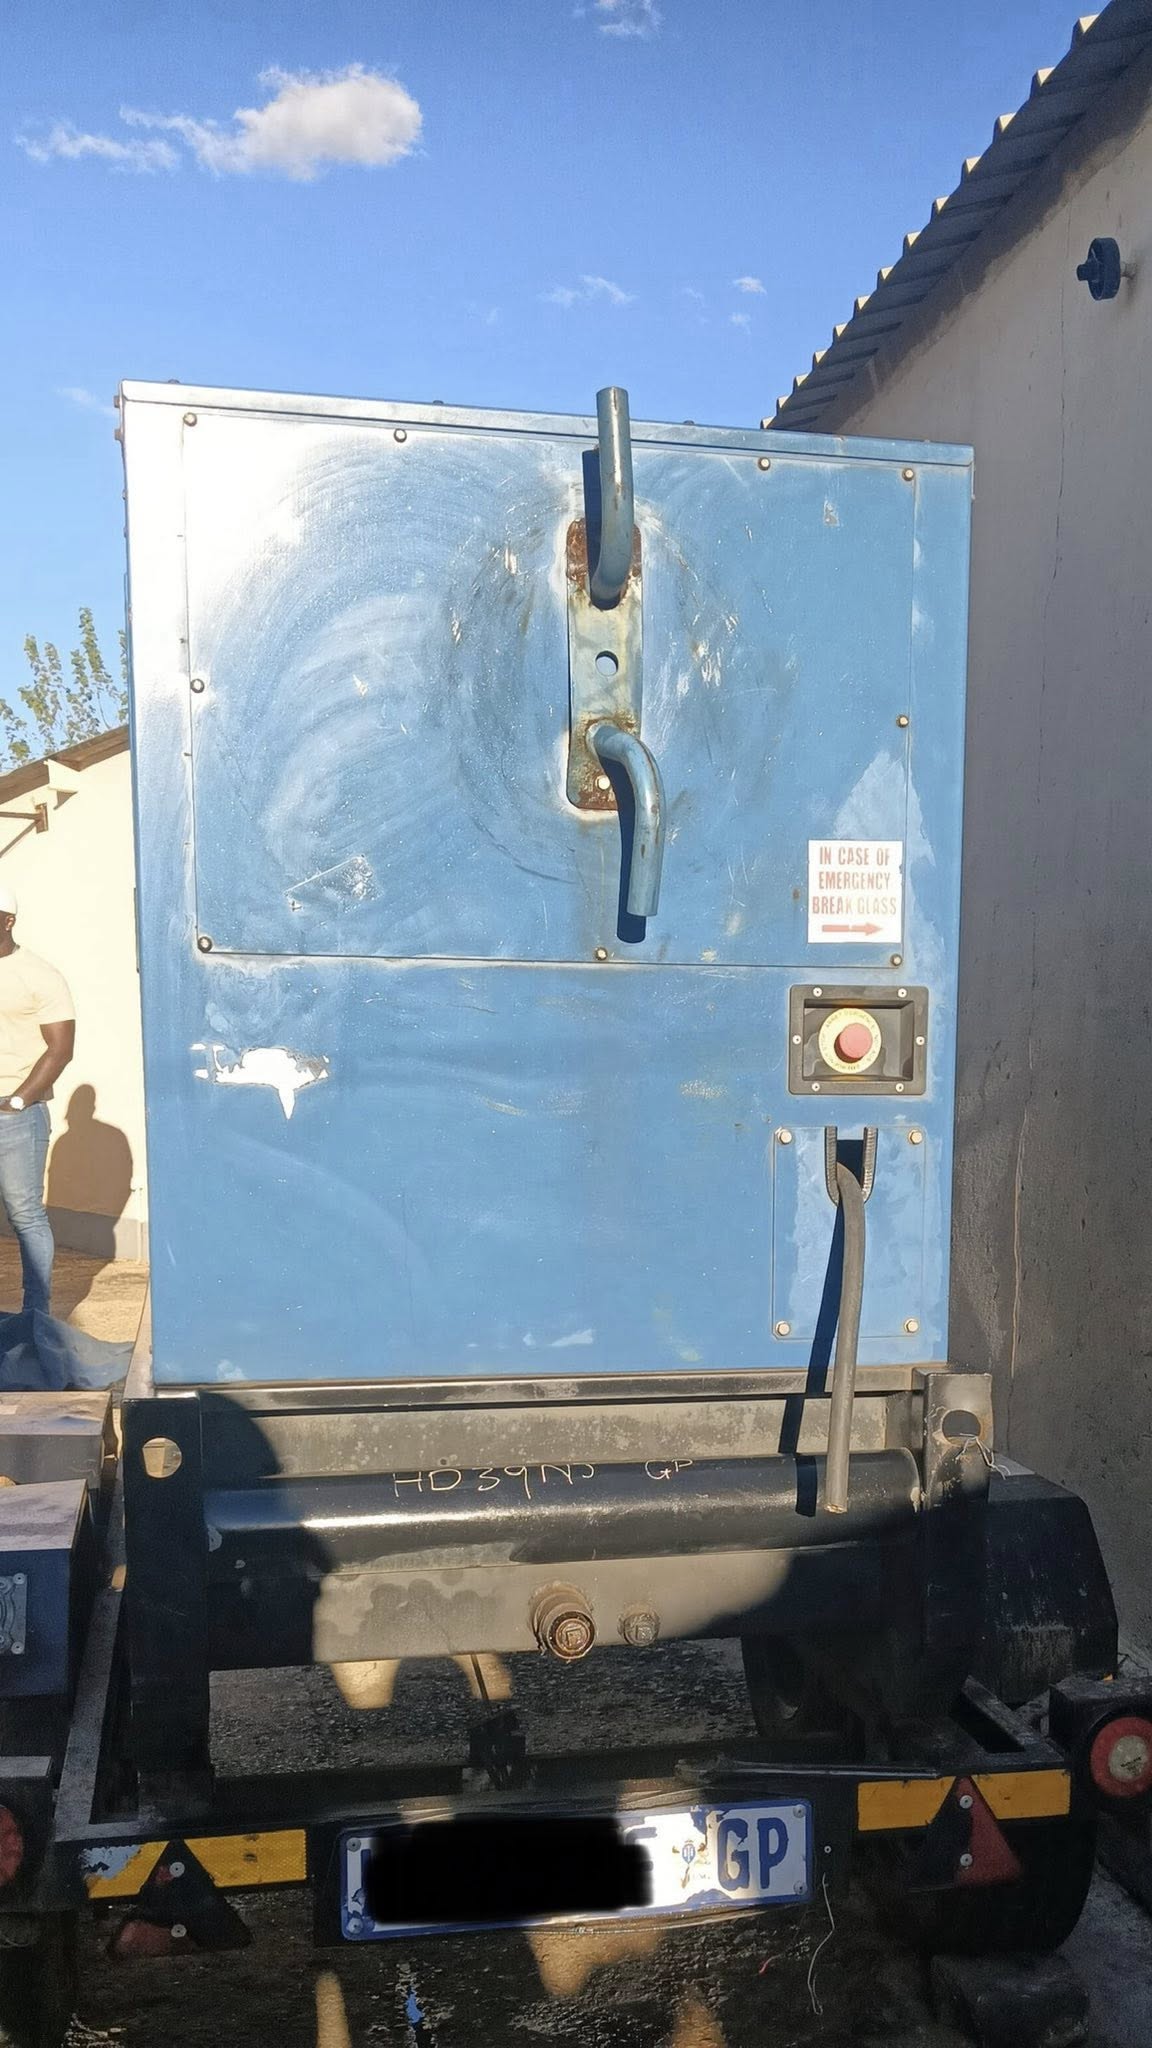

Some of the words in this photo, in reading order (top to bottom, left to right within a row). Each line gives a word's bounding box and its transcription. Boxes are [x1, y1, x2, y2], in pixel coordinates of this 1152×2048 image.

[819, 846, 832, 865] IN
[838, 846, 869, 866] CASE
[876, 847, 890, 866] OF
[818, 871, 891, 890] EMERGENCY
[812, 896, 853, 915] BREAK
[856, 897, 897, 915] GLASS
[644, 1459, 693, 1480] GP
[717, 1817, 789, 1891] GP
